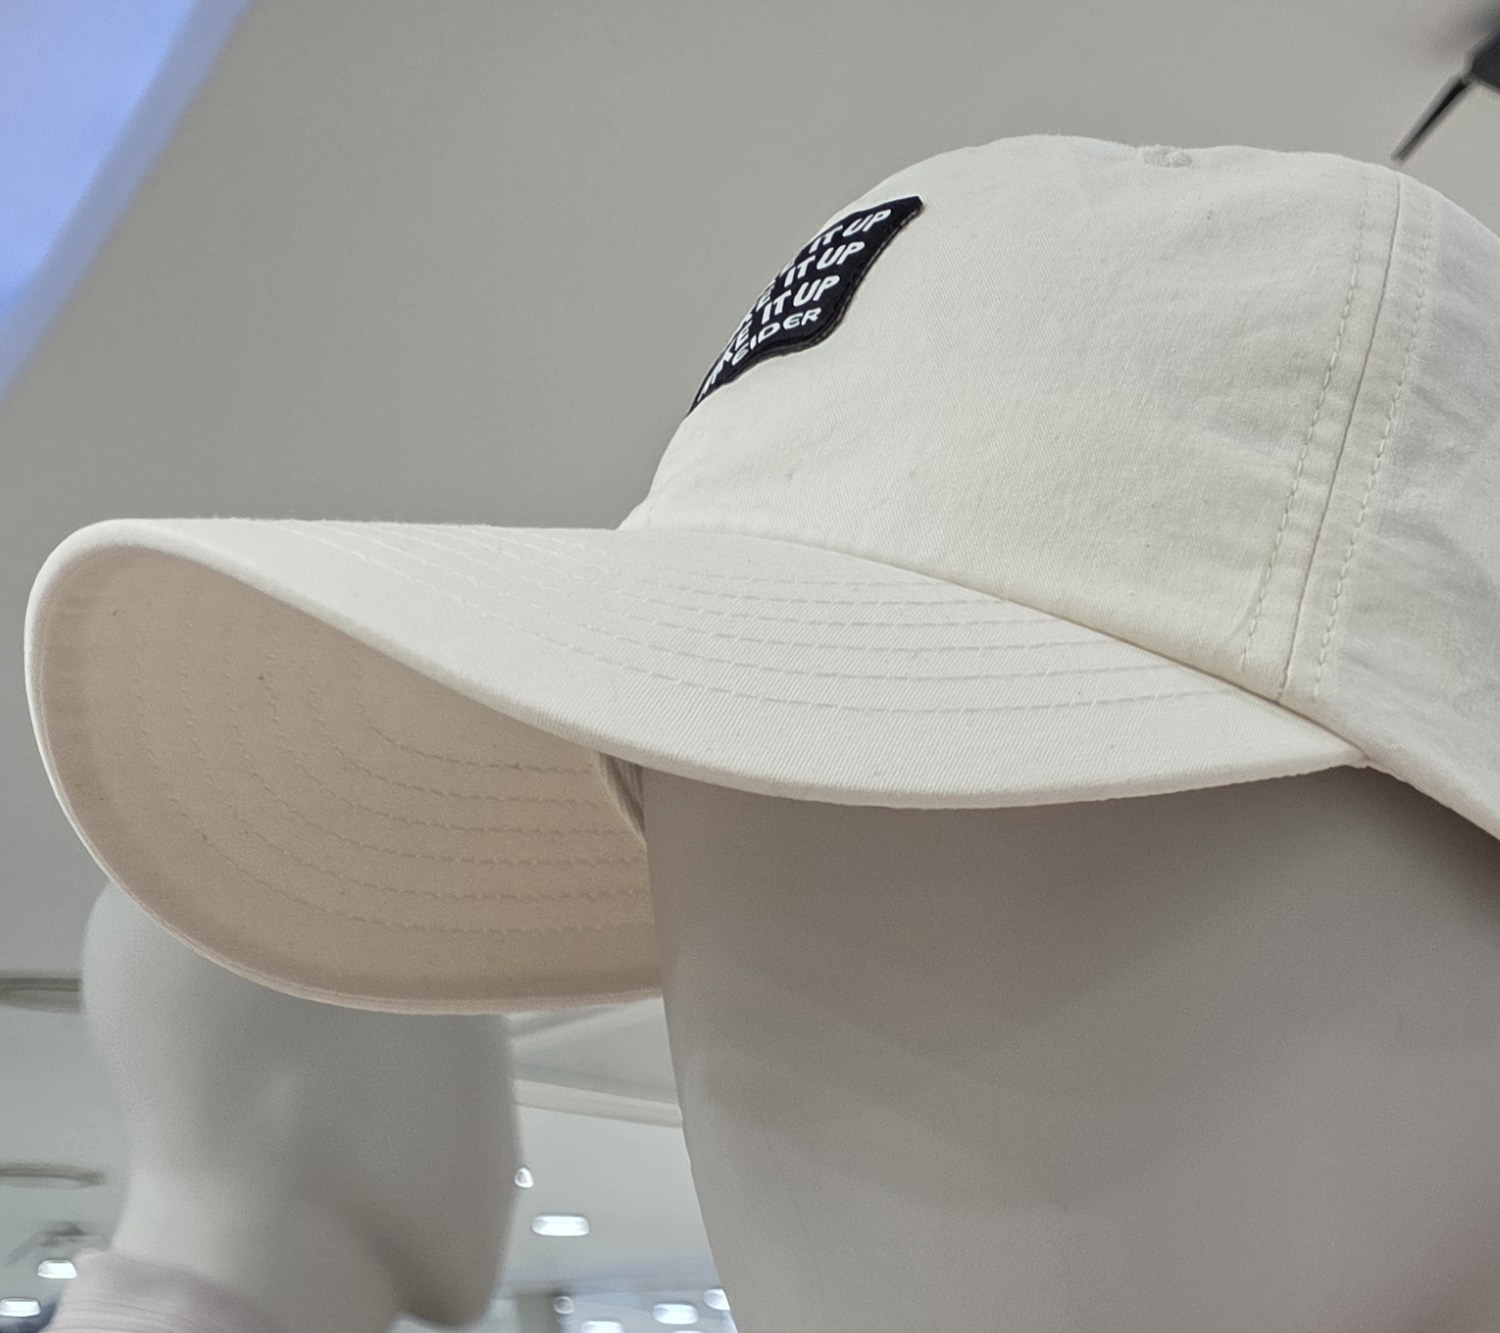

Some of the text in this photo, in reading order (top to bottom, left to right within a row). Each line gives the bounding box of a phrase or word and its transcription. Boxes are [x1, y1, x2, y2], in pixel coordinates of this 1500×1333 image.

[808, 209, 891, 254] IT UP
[783, 255, 816, 288] IT
[816, 241, 865, 270] UP
[761, 288, 792, 325] IT
[793, 275, 840, 307] UP
[731, 308, 822, 366] EIDER
